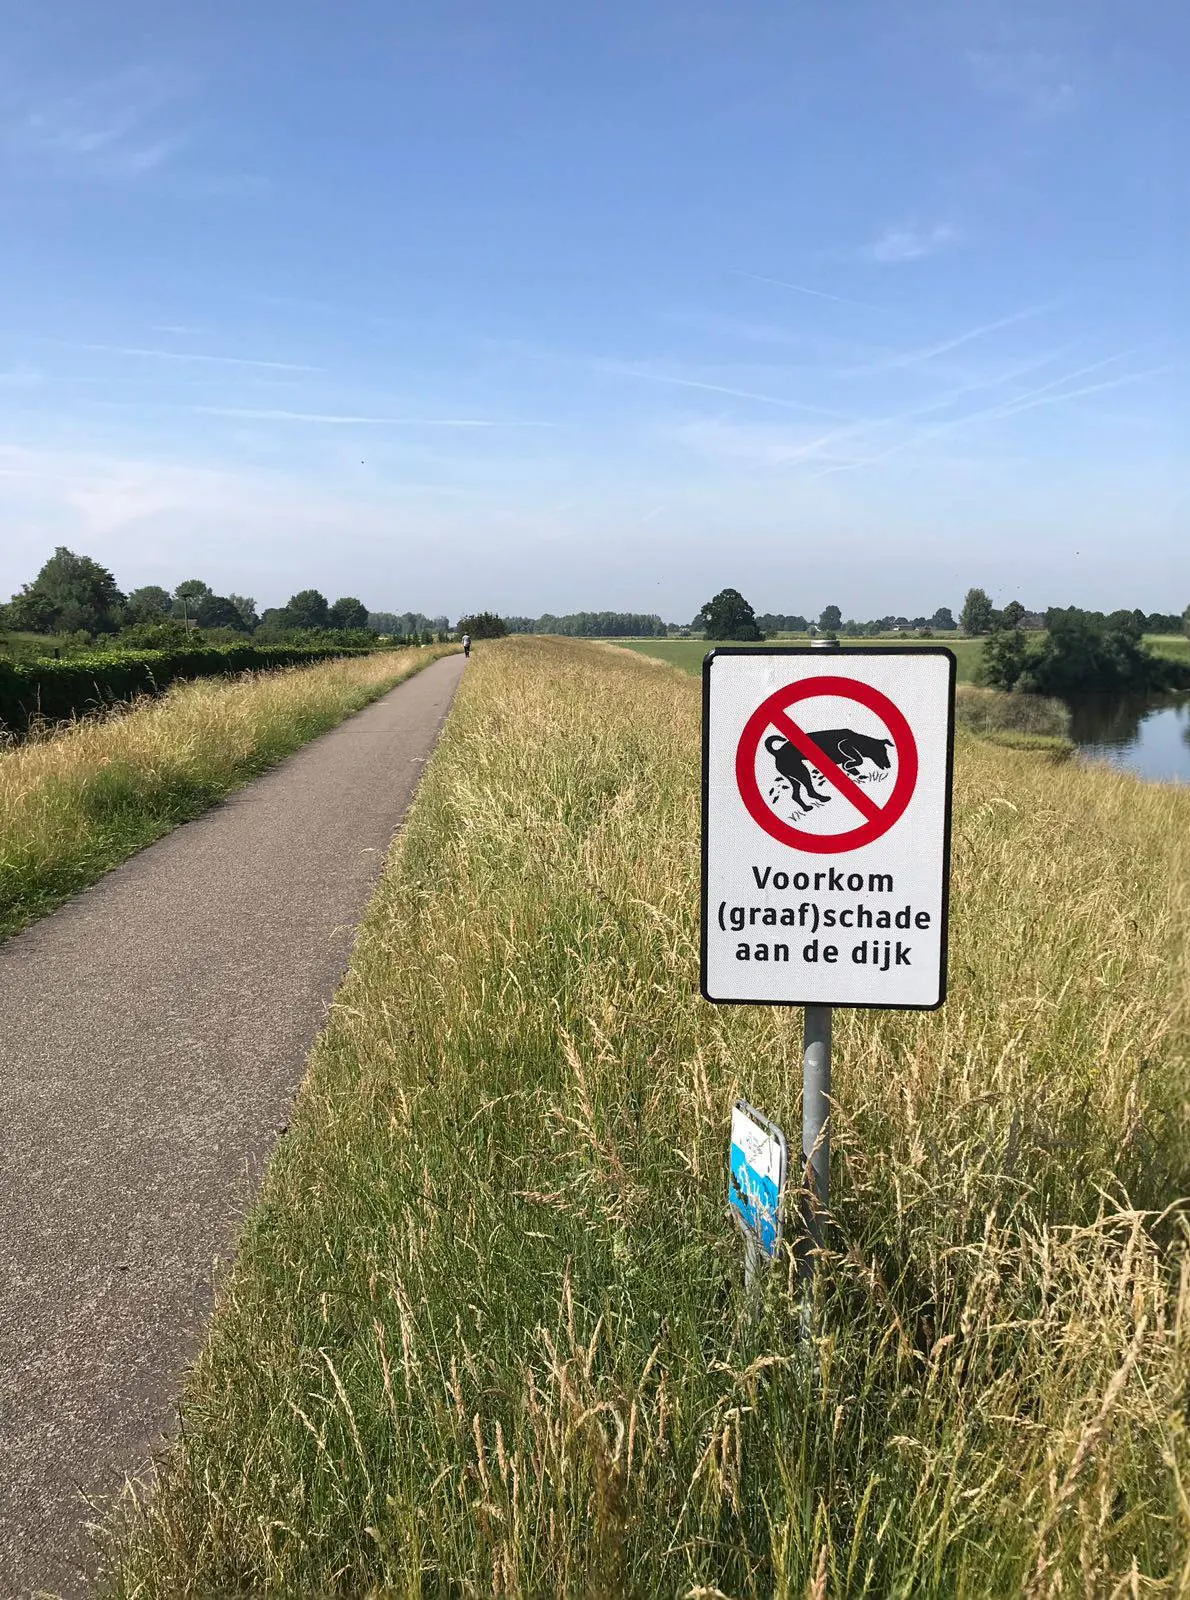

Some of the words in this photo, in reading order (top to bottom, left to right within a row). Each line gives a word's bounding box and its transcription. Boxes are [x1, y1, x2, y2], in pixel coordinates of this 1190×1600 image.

[751, 865, 894, 893] Voorkom
[718, 900, 931, 934] (graaf)schade
[735, 942, 790, 962] aan
[802, 938, 839, 964] de
[851, 940, 912, 972] dijk
